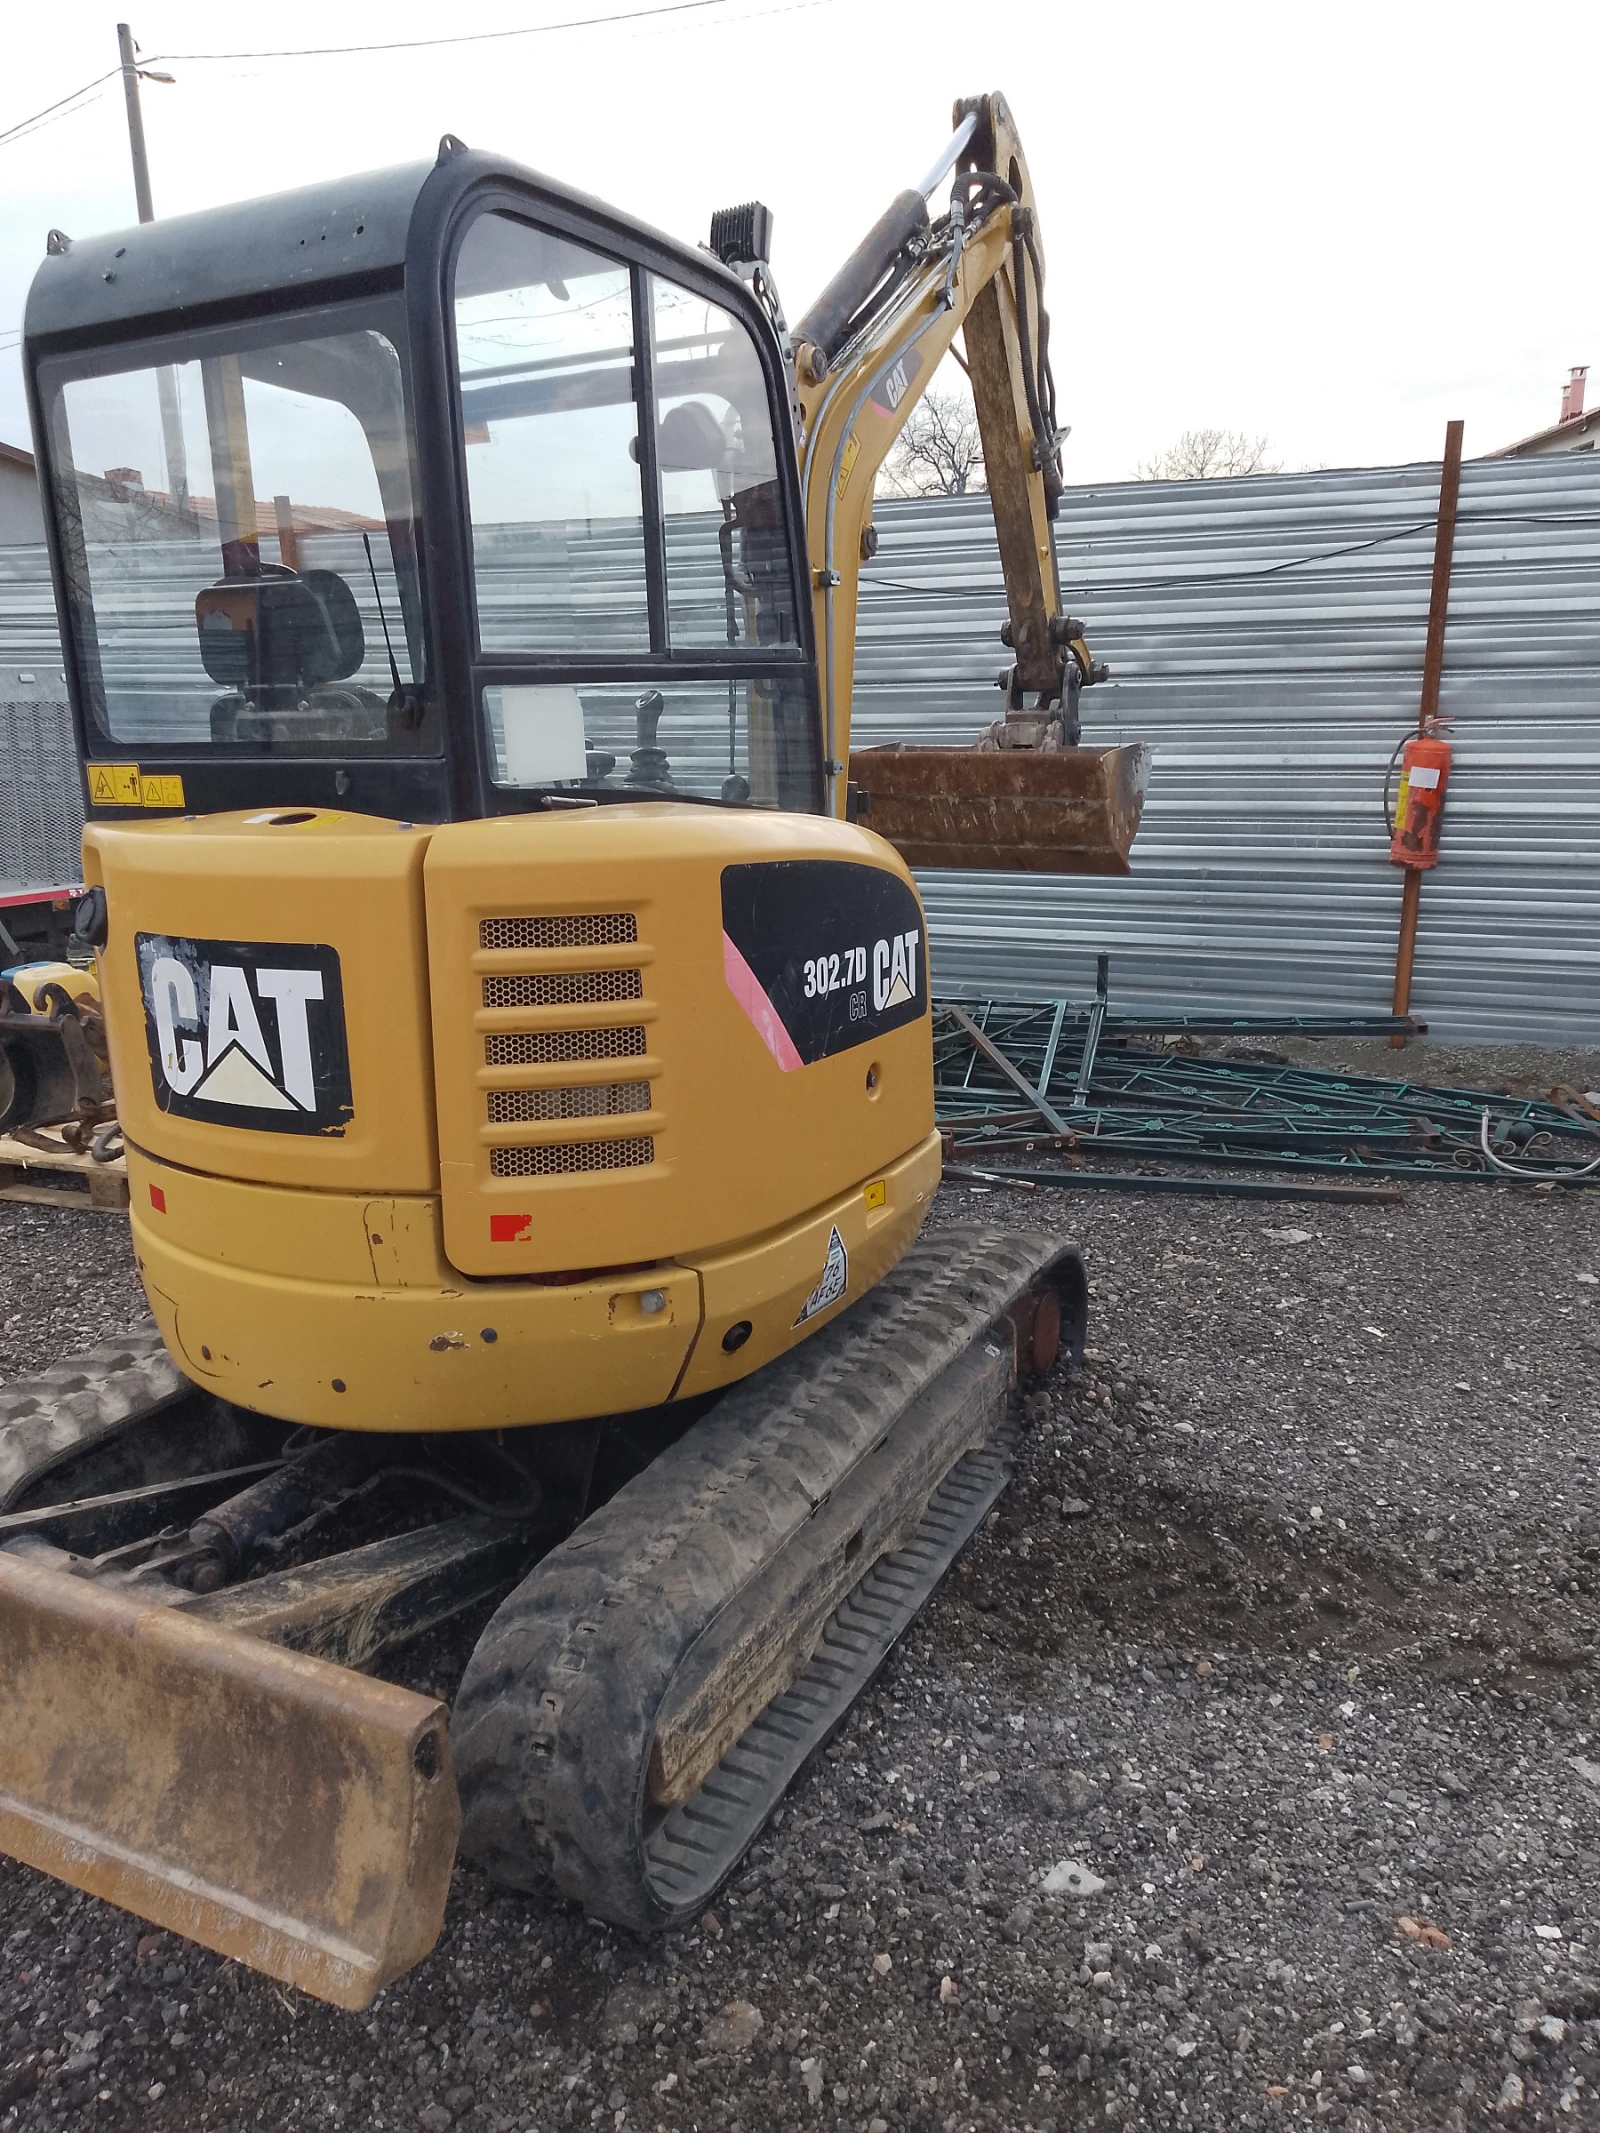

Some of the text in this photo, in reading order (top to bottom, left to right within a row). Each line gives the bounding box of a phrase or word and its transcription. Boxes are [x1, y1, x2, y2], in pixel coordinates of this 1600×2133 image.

[885, 358, 908, 409] CAT
[803, 946, 867, 998] 302.7D
[873, 929, 919, 1011] CAT
[849, 990, 867, 1021] CR
[151, 957, 324, 1112] CAT
